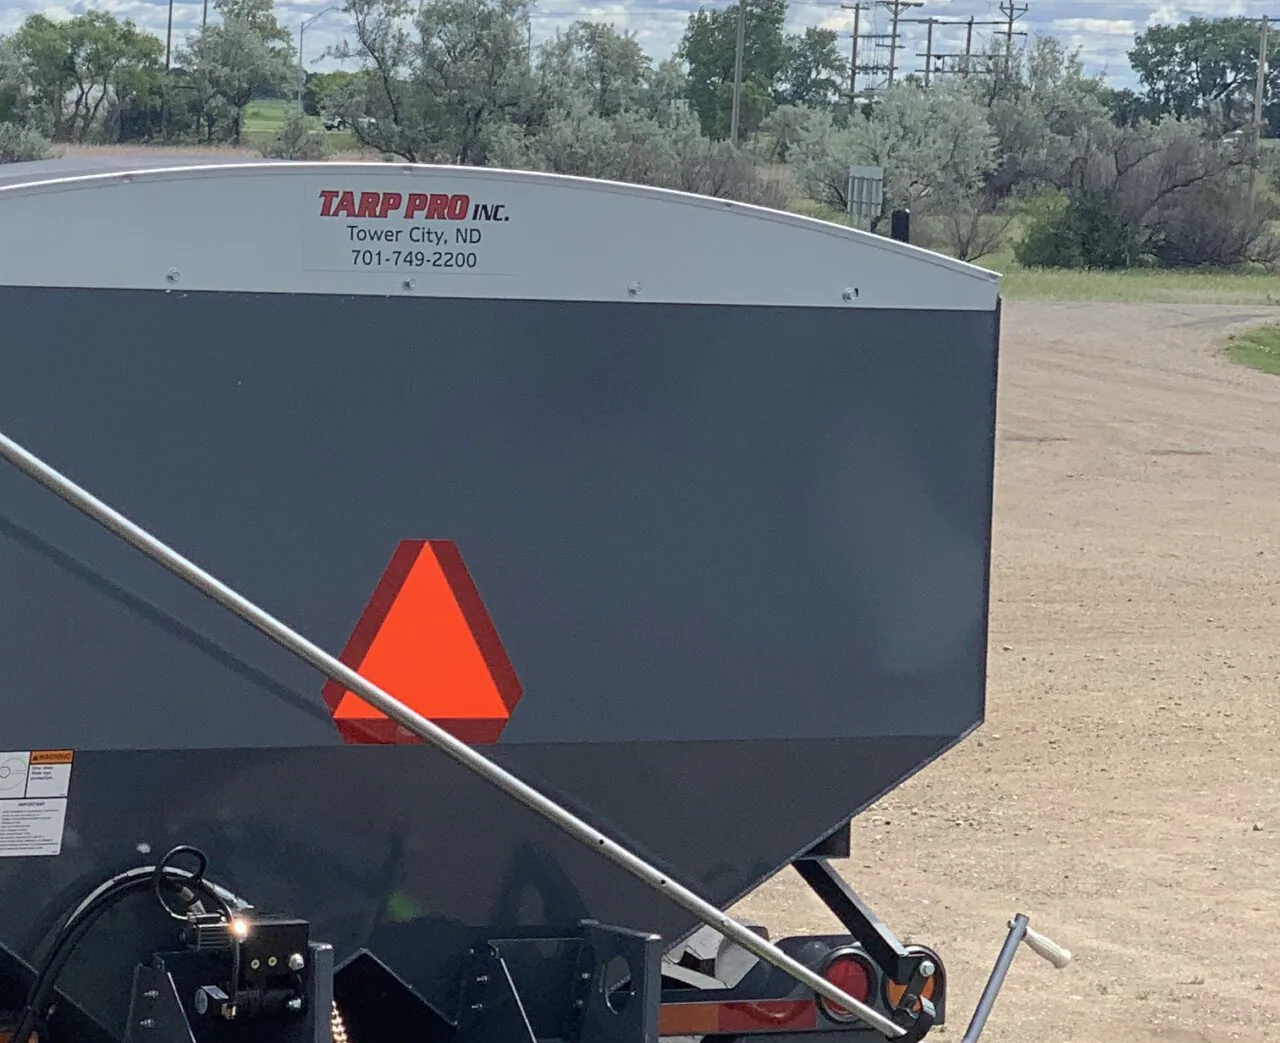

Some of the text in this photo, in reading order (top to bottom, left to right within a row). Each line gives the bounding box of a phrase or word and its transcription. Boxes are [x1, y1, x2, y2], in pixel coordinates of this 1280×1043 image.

[319, 190, 510, 222] TARP PRO INC.
[346, 225, 482, 245] Tower City, ND
[351, 249, 477, 268] 701-749-2200
